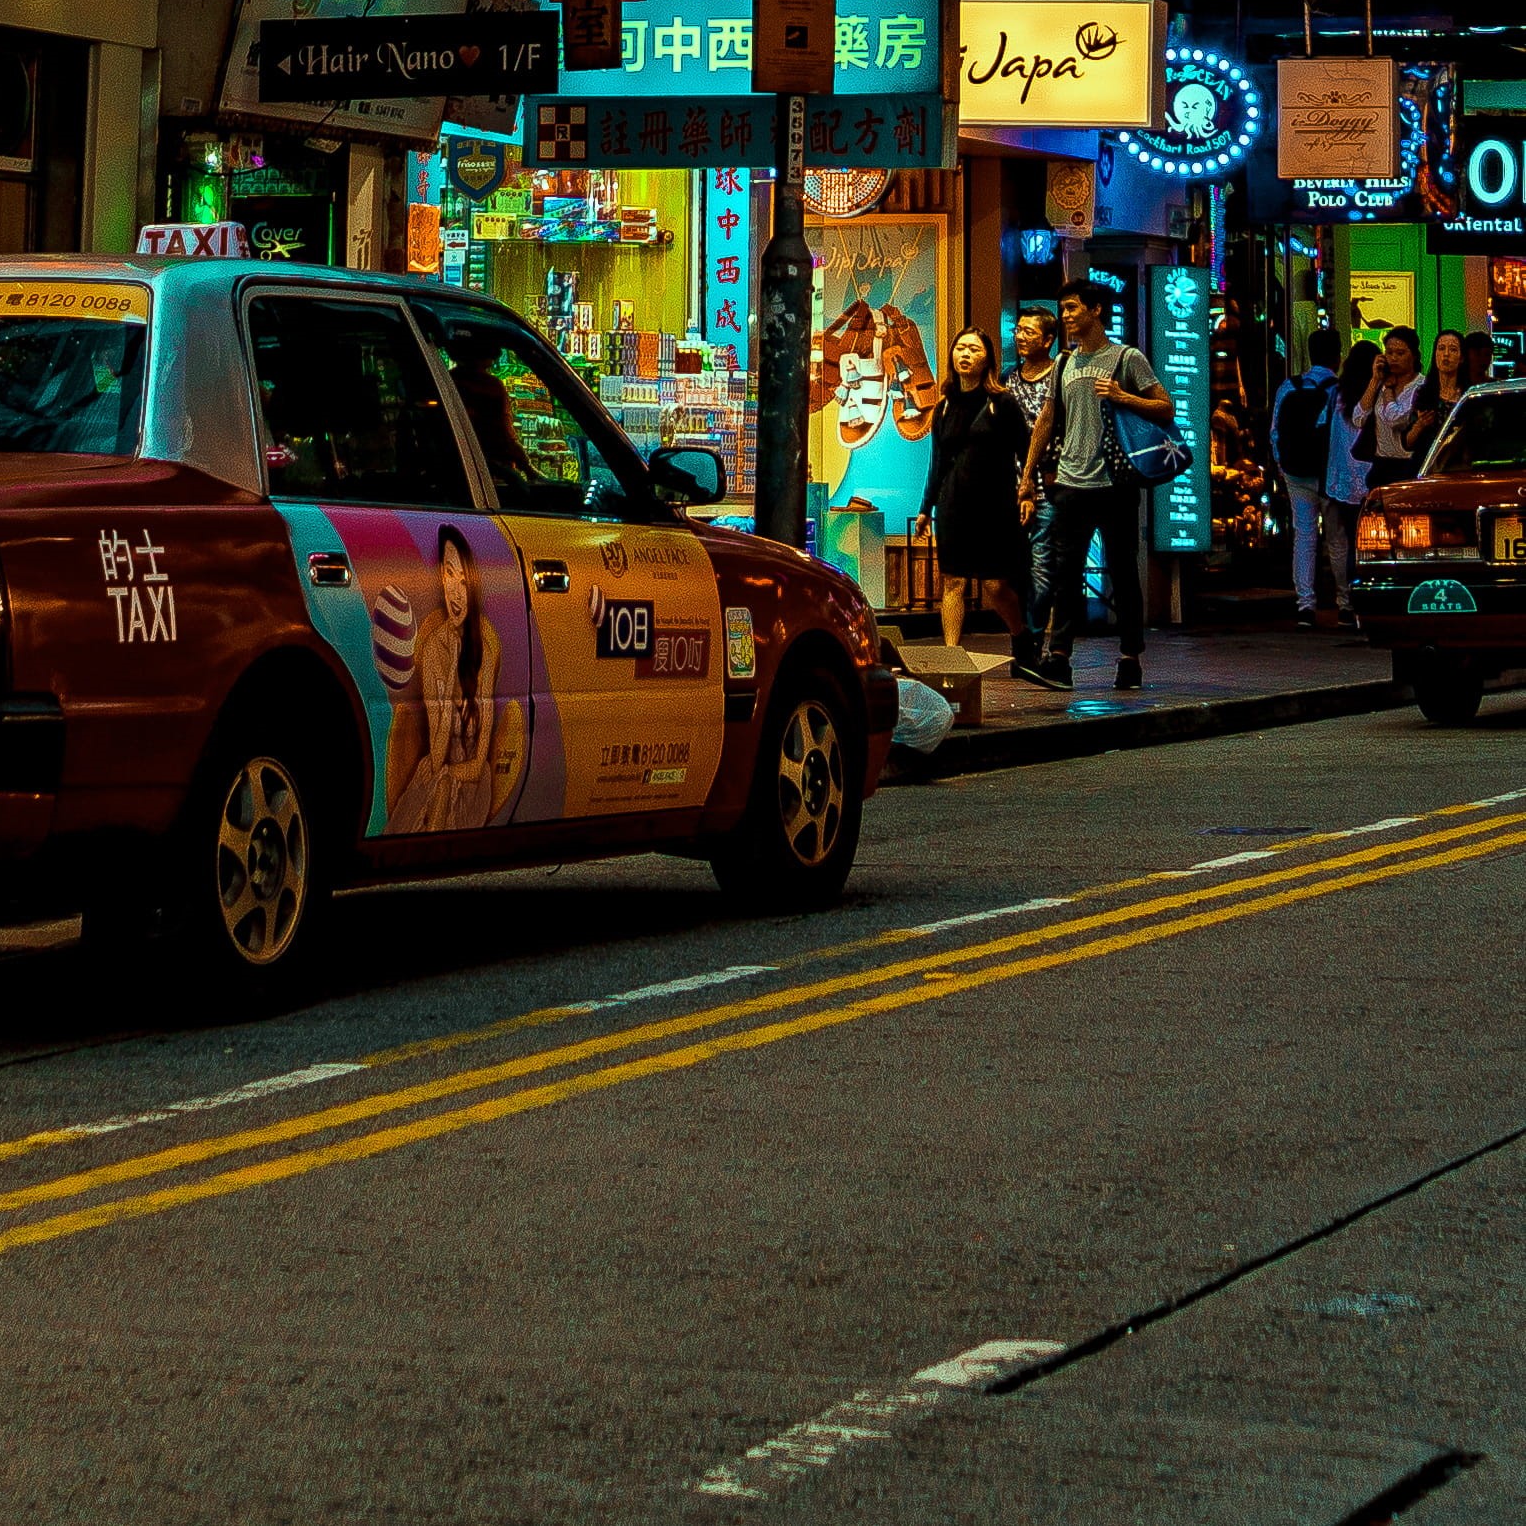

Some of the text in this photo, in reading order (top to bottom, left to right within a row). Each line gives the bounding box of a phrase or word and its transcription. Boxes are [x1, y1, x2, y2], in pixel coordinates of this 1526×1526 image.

[298, 40, 542, 83] Hair Nano 1/F
[966, 30, 1085, 104] Japa
[599, 107, 753, 160] 註冊藥師
[1186, 139, 1212, 155] Road
[1211, 129, 1232, 150] 507
[144, 226, 230, 257] TAXI
[251, 220, 303, 248] Cover
[80, 296, 132, 312] 0088
[99, 528, 168, 584] 的士
[1434, 588, 1447, 602] 4
[107, 586, 178, 645] TAXI
